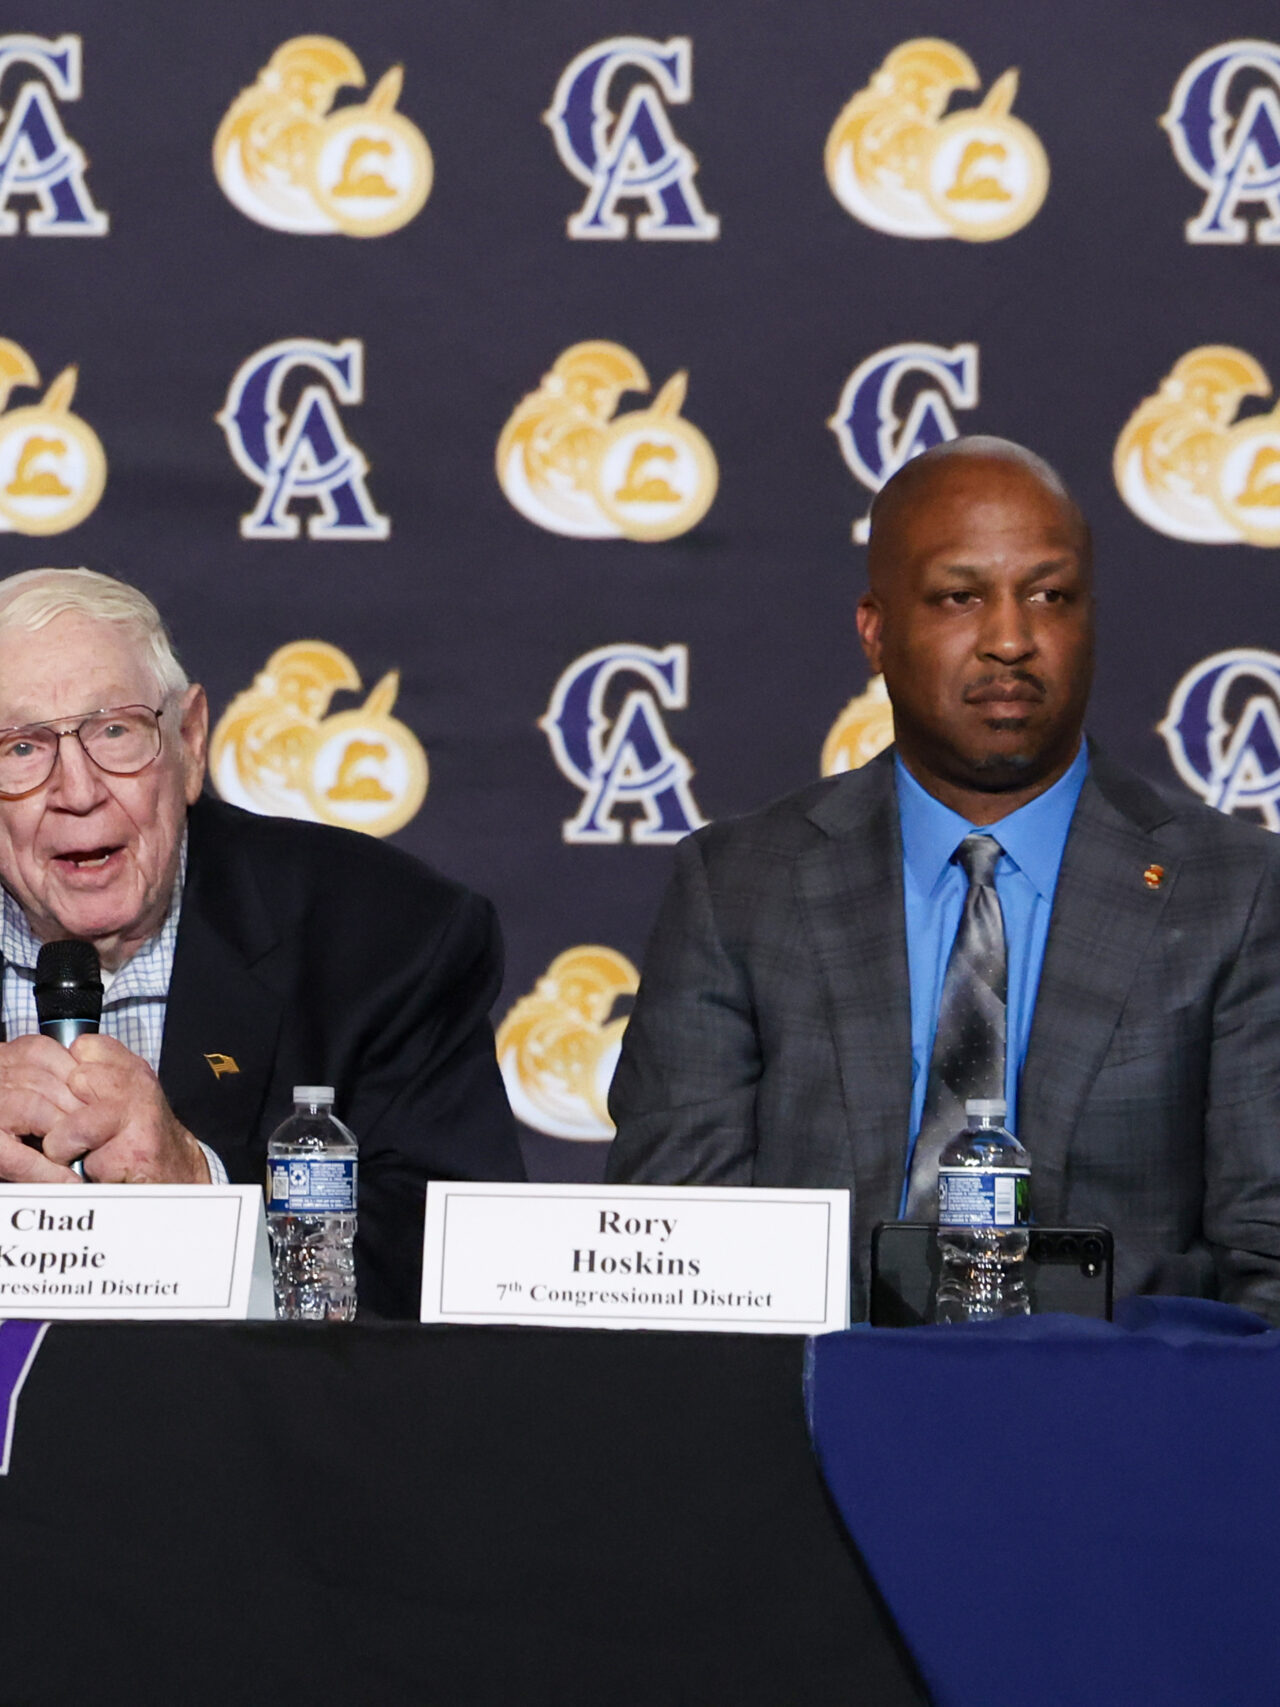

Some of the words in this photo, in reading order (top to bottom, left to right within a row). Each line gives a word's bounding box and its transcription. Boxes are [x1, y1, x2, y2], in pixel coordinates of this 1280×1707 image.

[543, 36, 720, 241] CA
[216, 338, 391, 540] CA
[538, 643, 711, 845] CA
[10, 1208, 95, 1231] Chad
[598, 1210, 677, 1242] Rory
[572, 1248, 701, 1276] Hoskins
[101, 1279, 179, 1295] District
[496, 1281, 522, 1300] 7th
[529, 1285, 684, 1306] Congressional
[691, 1289, 772, 1307] District
